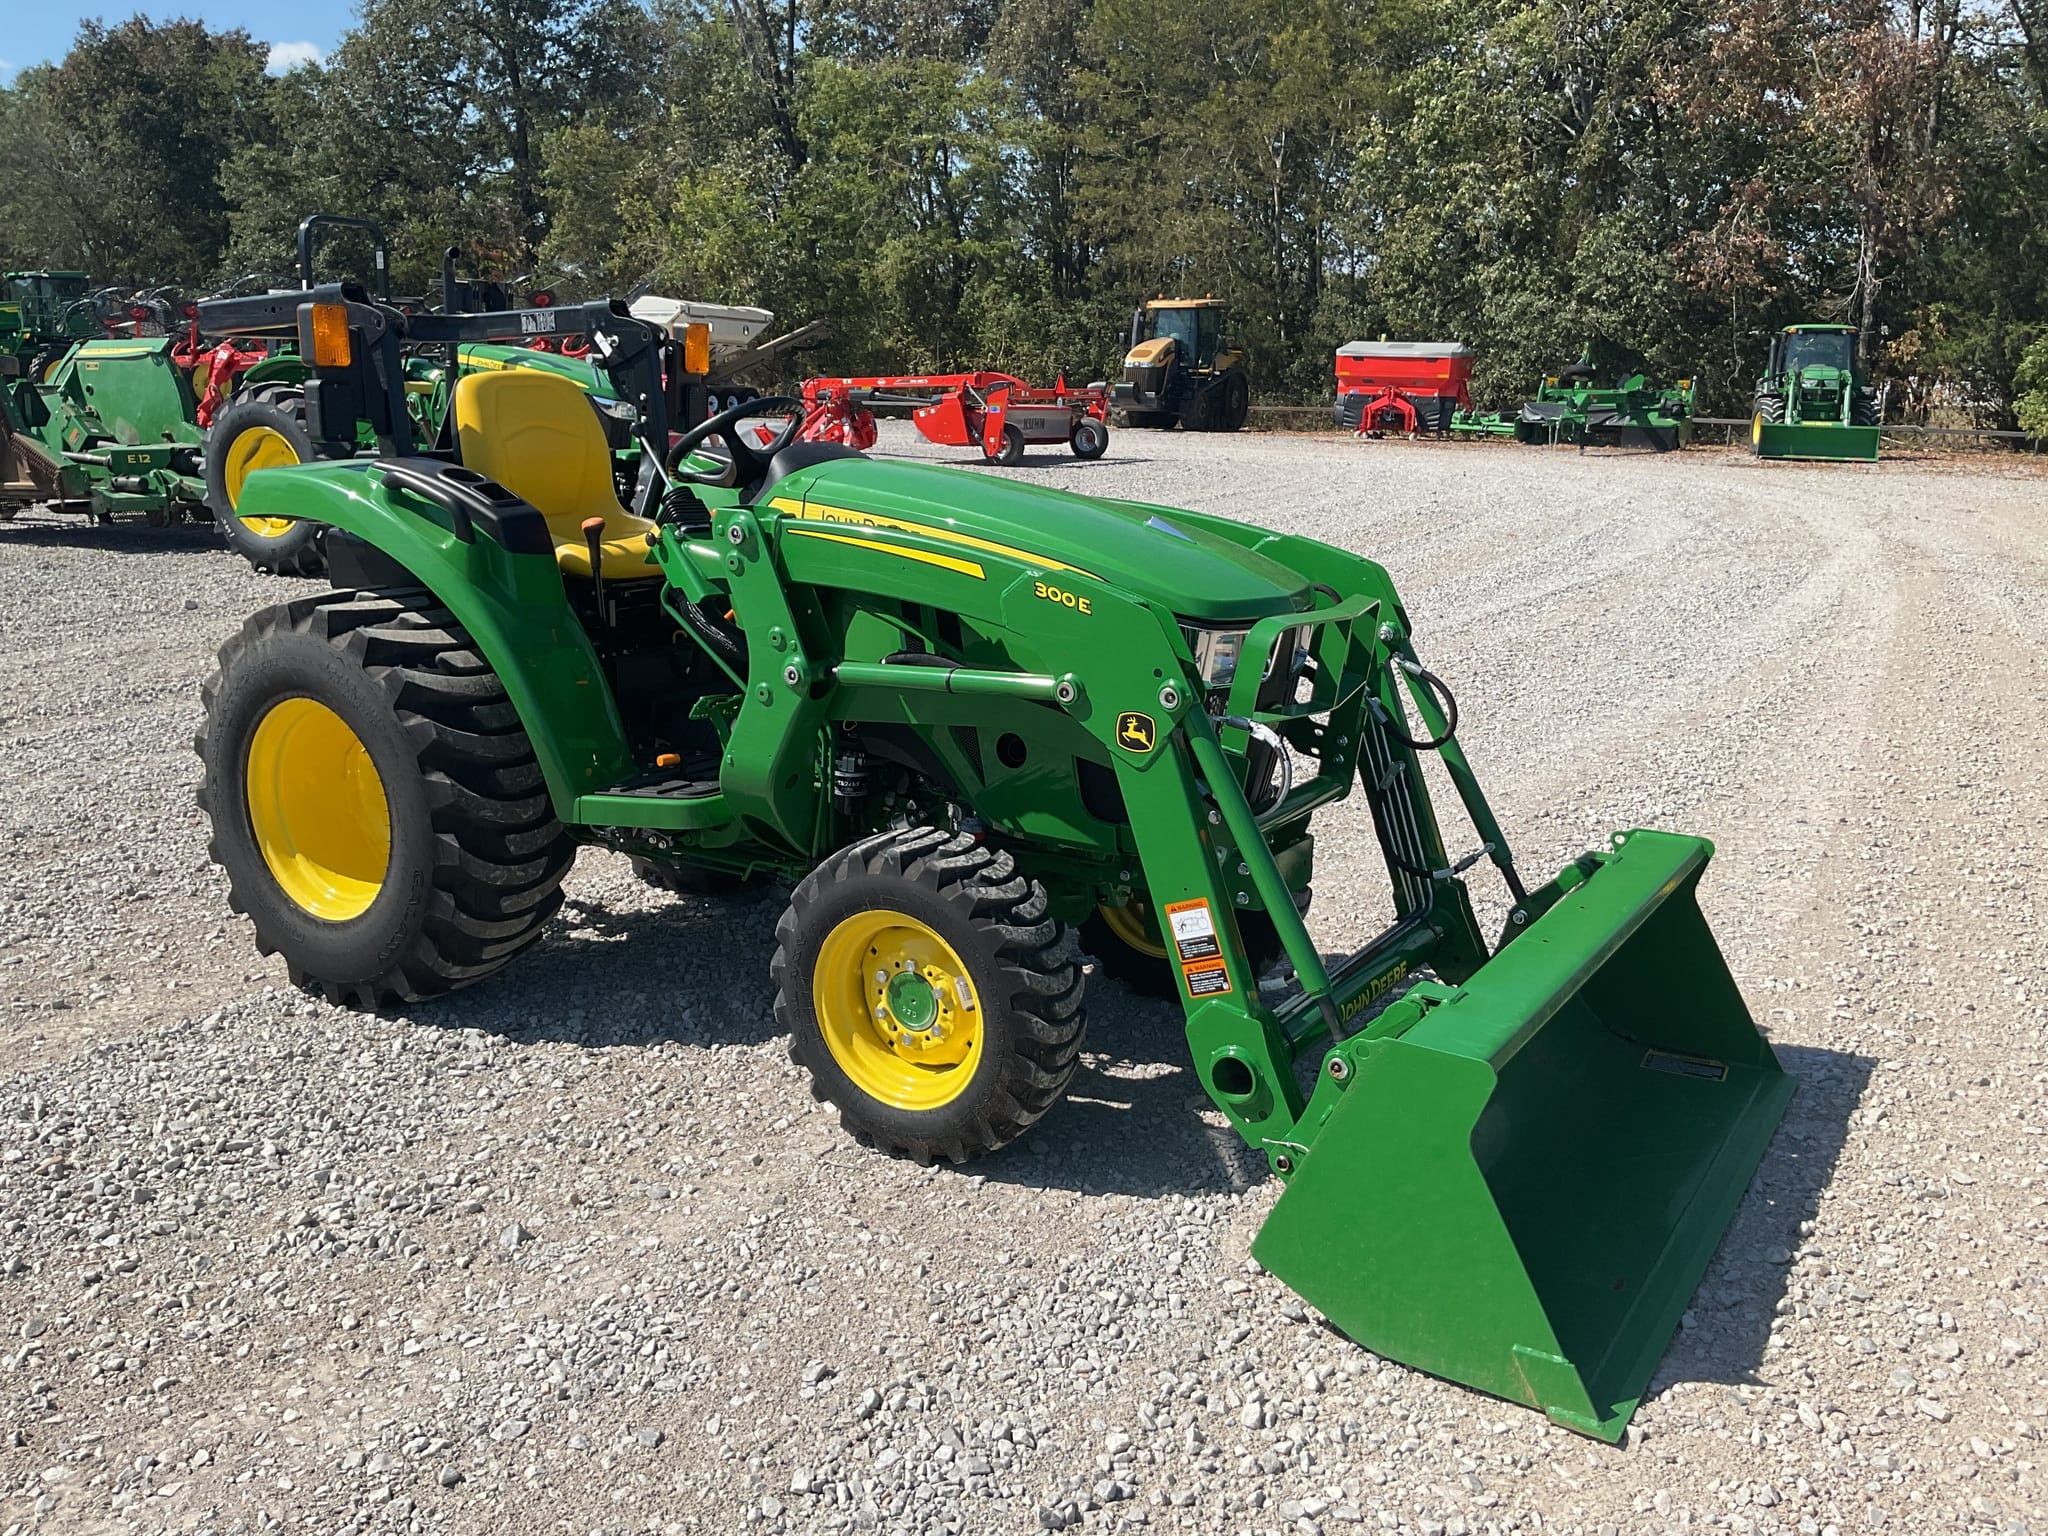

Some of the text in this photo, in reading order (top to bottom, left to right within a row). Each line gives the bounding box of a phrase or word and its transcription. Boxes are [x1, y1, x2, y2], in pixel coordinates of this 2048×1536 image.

[1023, 418, 1045, 430] KUHN
[1341, 960, 1407, 1024] JOHN DEERE
